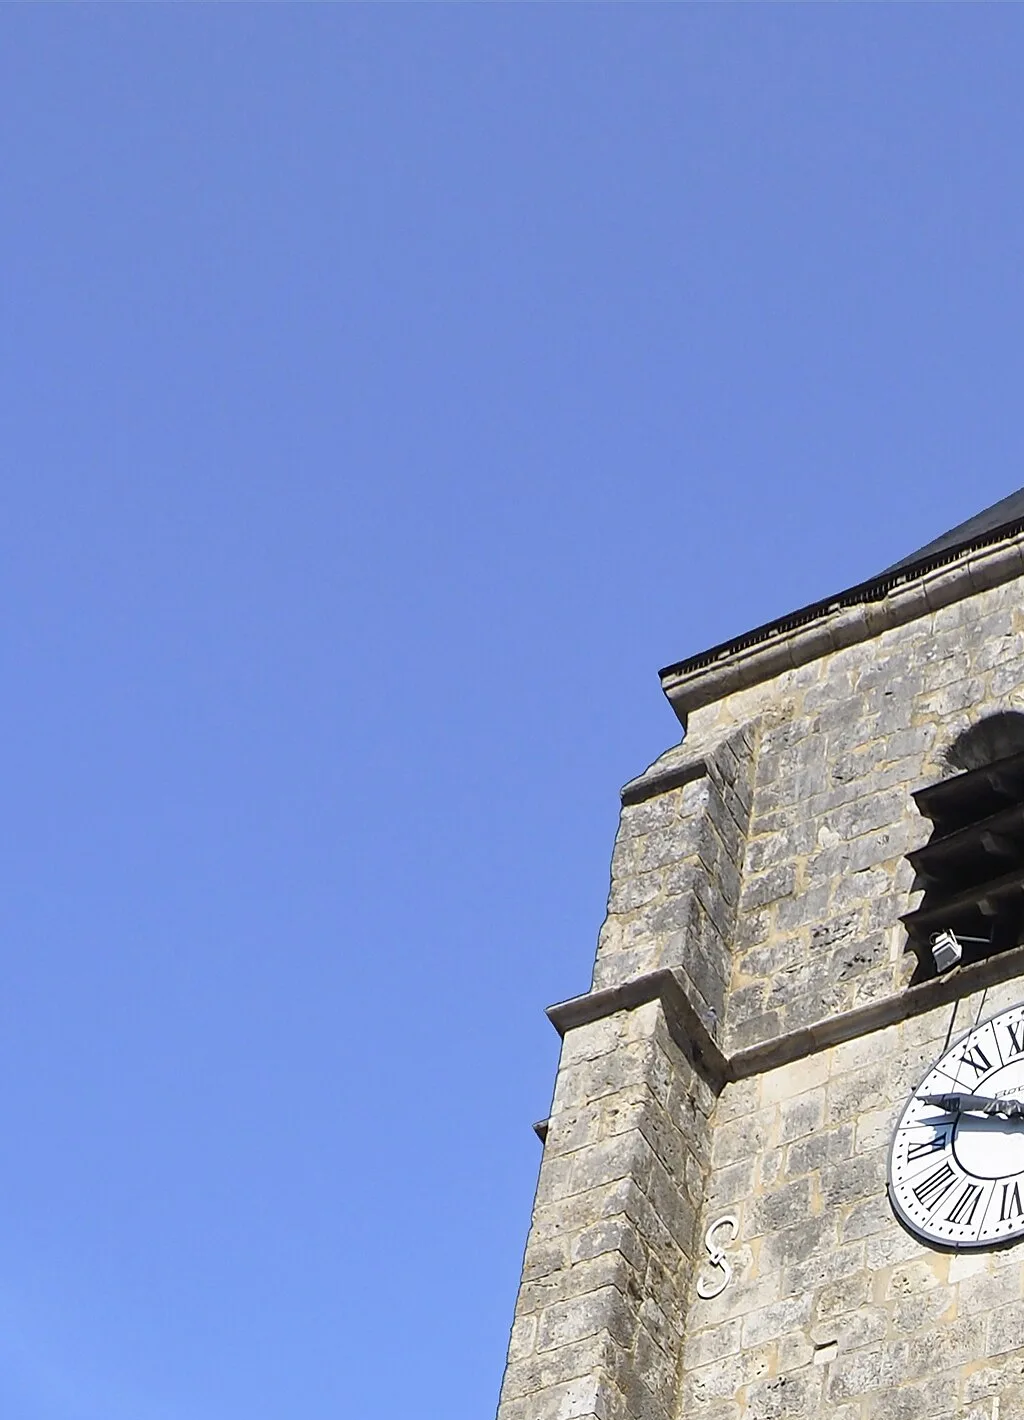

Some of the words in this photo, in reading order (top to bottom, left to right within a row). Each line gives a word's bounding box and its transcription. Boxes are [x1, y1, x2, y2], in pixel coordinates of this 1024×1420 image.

[960, 1045, 993, 1079] XI
[908, 1135, 946, 1163] IX
[913, 1160, 959, 1211] VIII
[945, 1183, 985, 1225] VII
[999, 1181, 1023, 1221] VI
